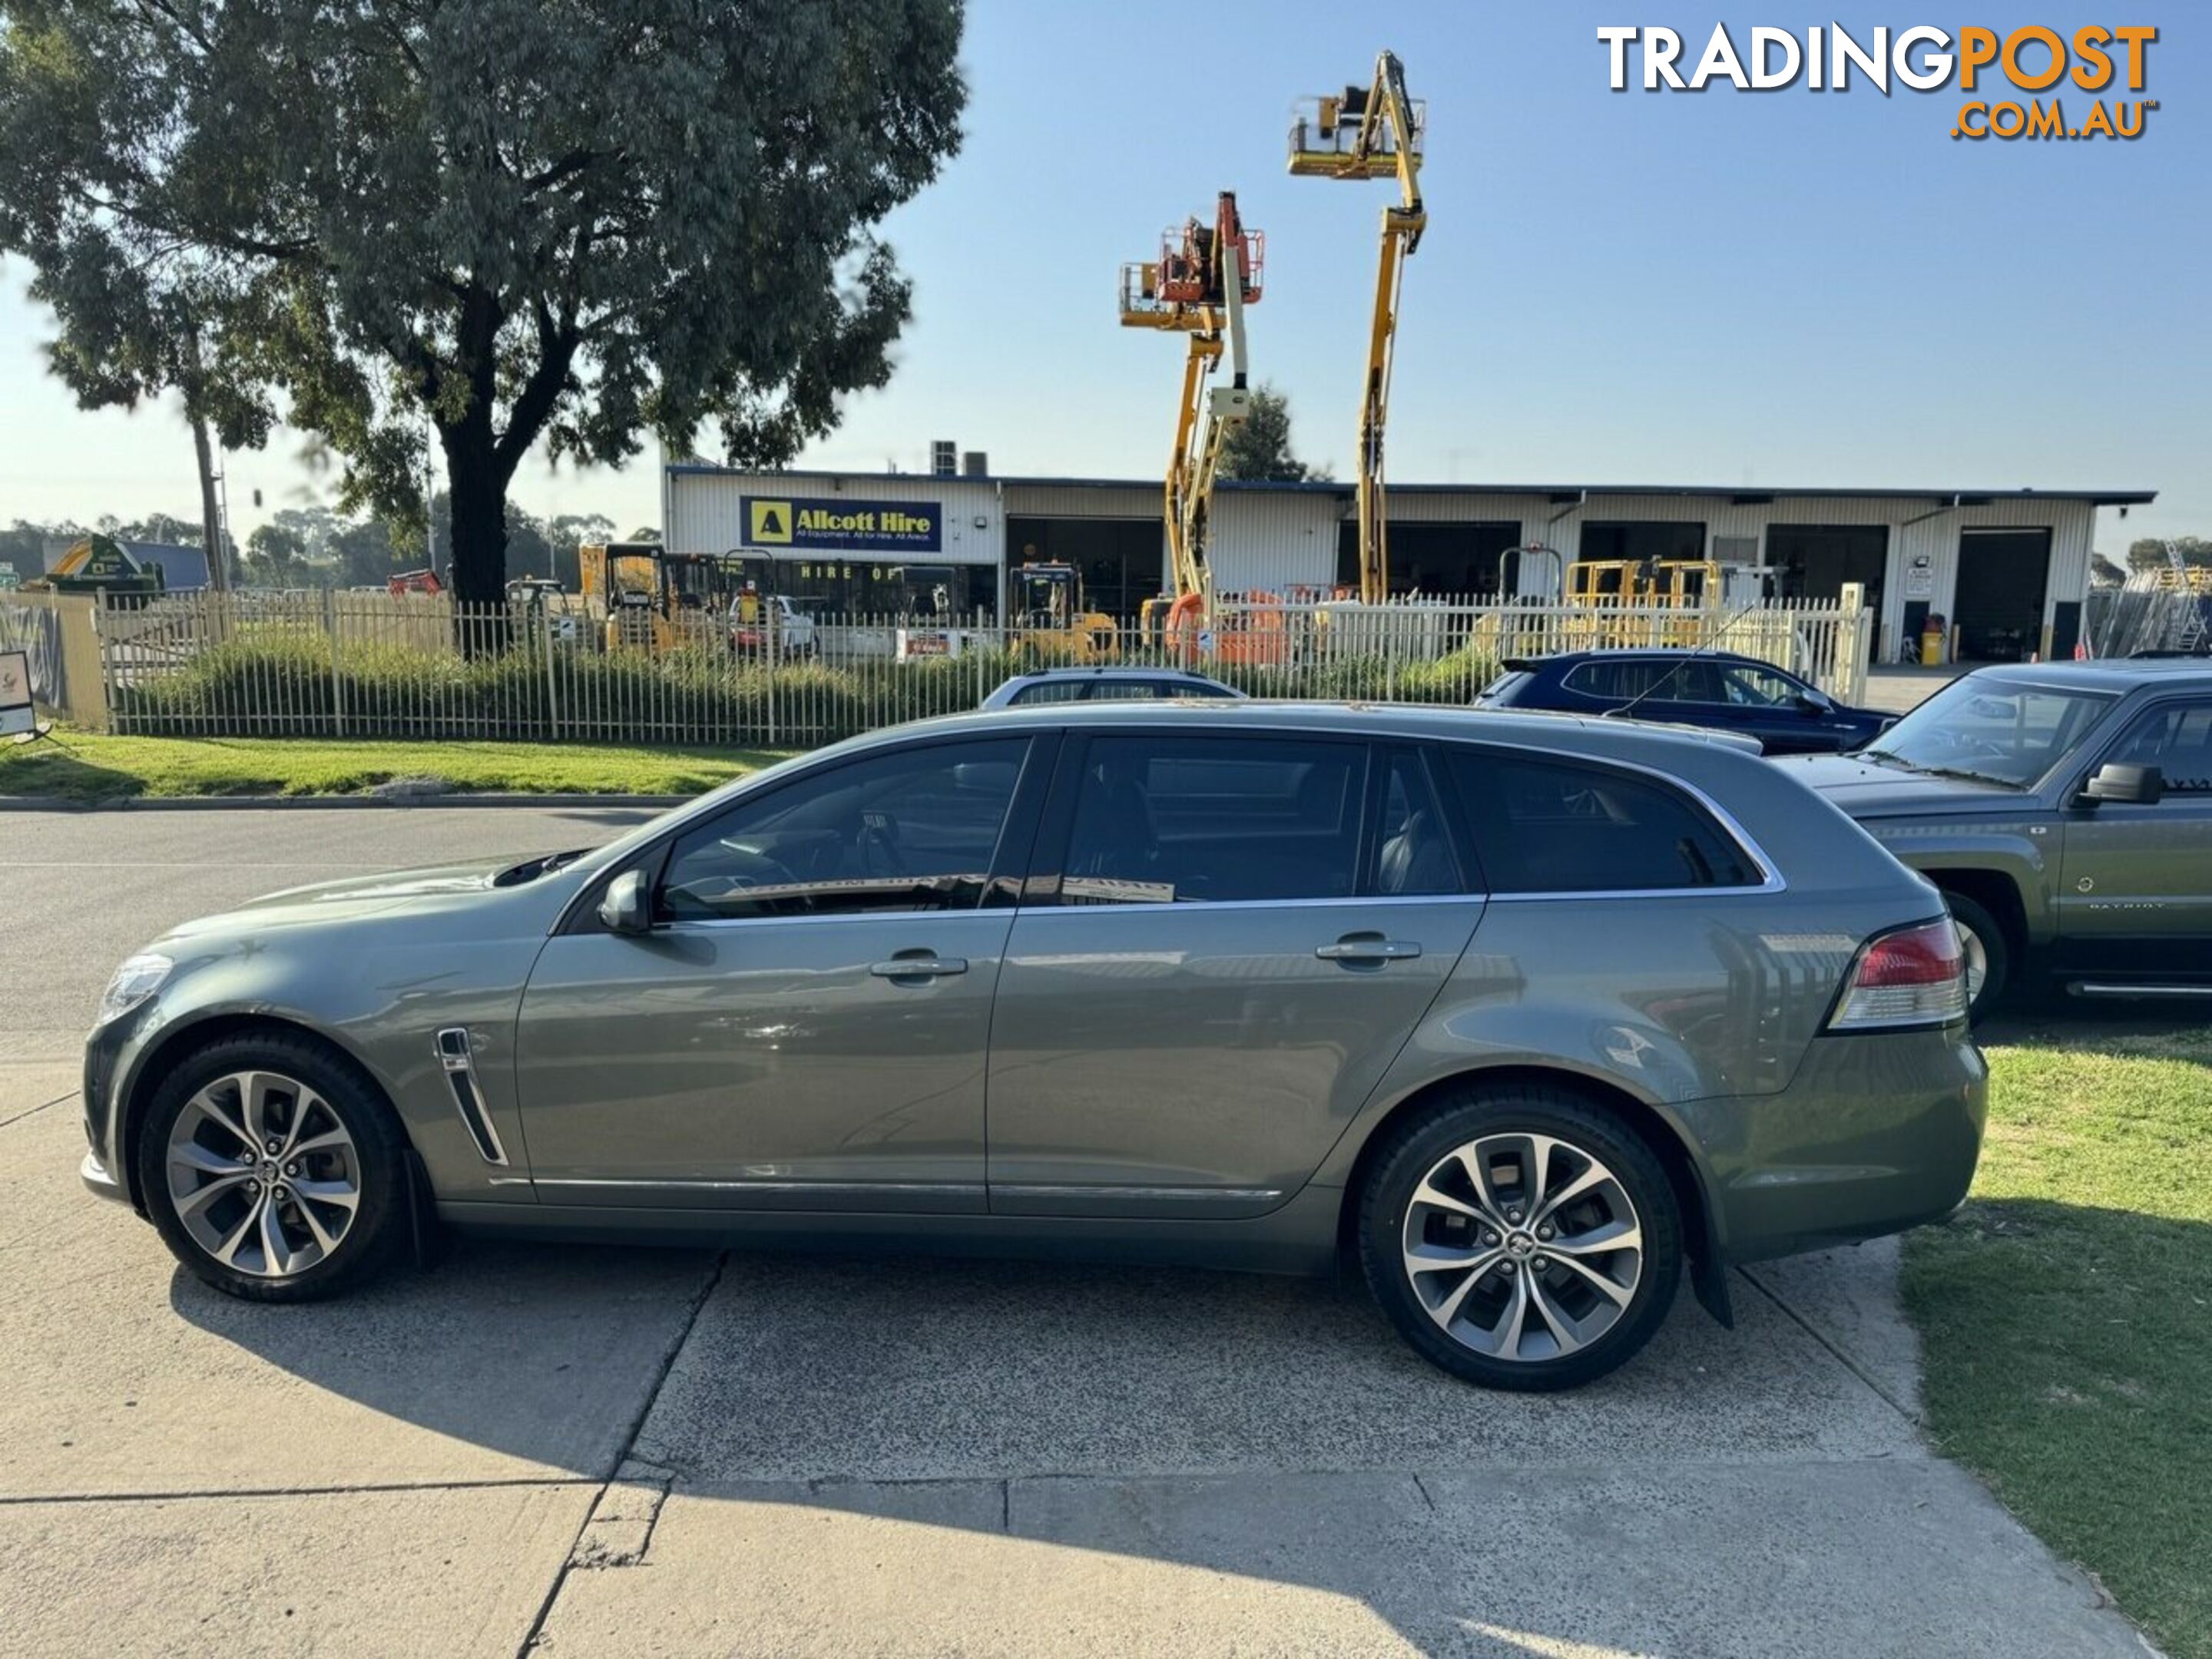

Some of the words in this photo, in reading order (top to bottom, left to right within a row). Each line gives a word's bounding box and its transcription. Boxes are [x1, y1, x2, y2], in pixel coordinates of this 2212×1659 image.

[796, 509, 875, 531] Allcott
[881, 512, 931, 533] Hire
[801, 566, 852, 578] HIRE
